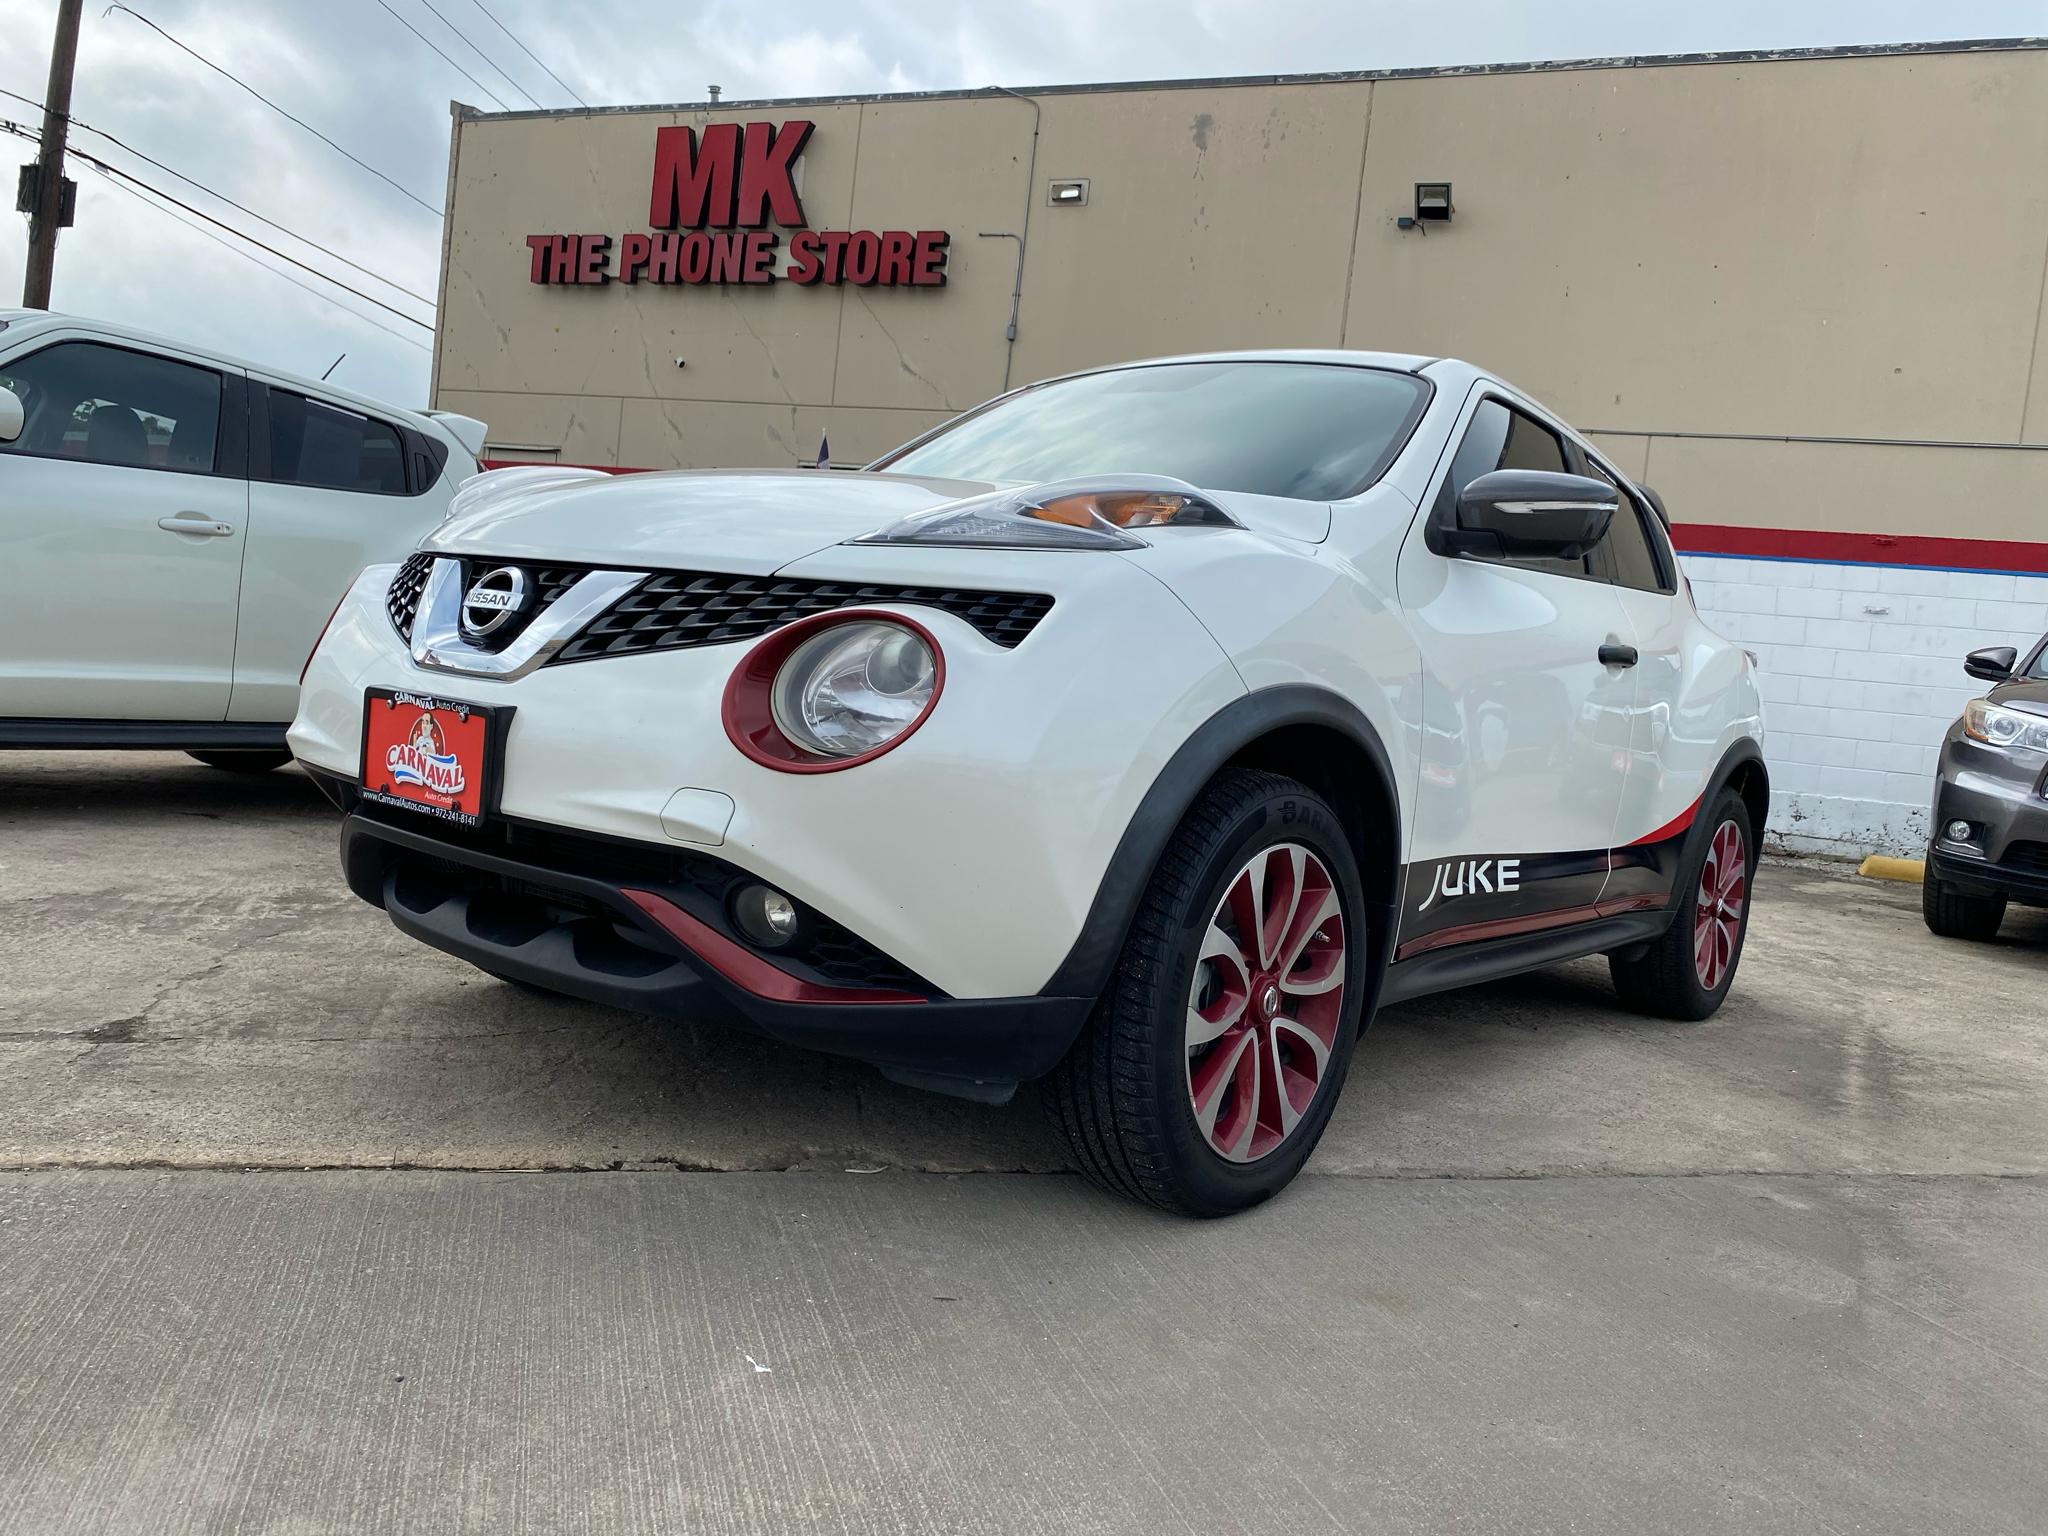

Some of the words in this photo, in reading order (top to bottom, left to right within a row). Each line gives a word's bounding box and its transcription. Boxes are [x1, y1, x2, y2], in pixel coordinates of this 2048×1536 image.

[649, 121, 816, 229] MK
[526, 234, 612, 286] THE
[619, 232, 780, 286] PHONE
[787, 231, 950, 287] STORE
[467, 592, 511, 606] NISSAN
[394, 692, 435, 710] CARNAVAL
[436, 699, 451, 711] Auto
[451, 702, 470, 715] Credit
[386, 744, 465, 791] CARNAVAL
[362, 791, 431, 815] www.CarnavalAutos.com
[435, 807, 476, 826] 972-241-8141
[424, 791, 437, 801] Auto
[436, 794, 454, 805] Credit
[1418, 859, 1520, 912] JUKE
